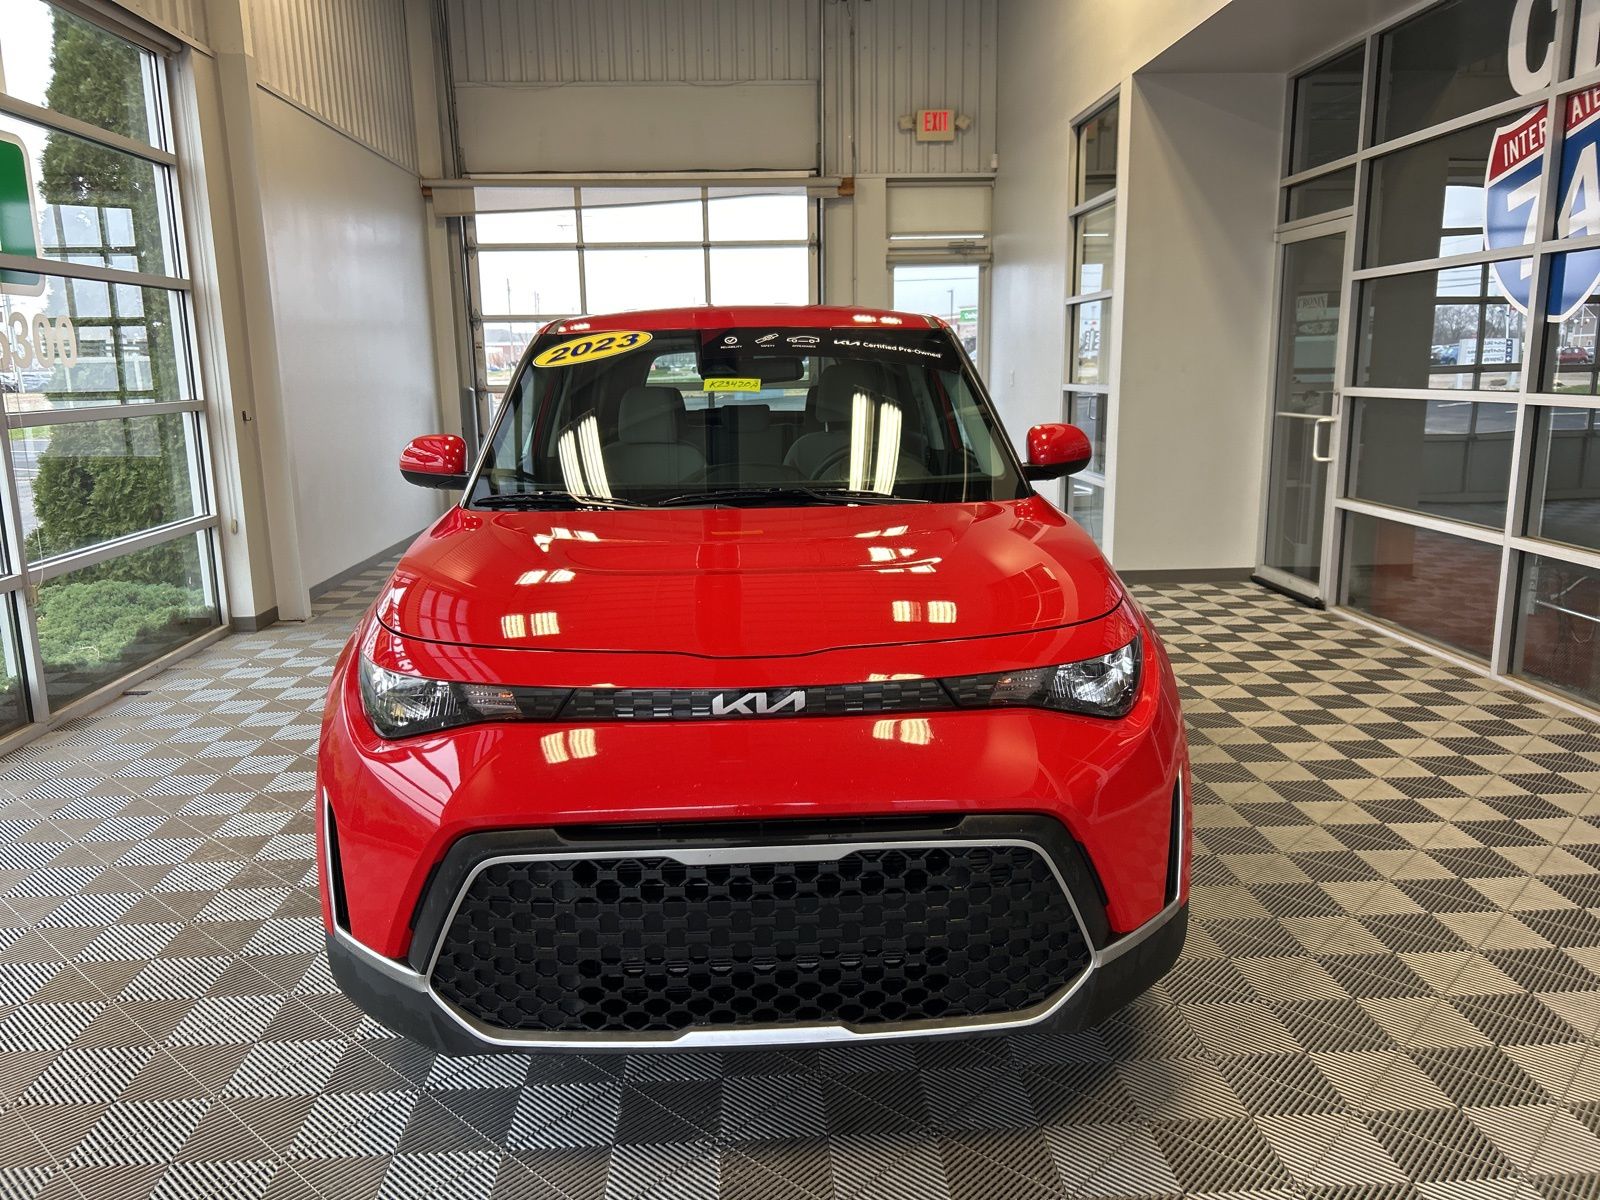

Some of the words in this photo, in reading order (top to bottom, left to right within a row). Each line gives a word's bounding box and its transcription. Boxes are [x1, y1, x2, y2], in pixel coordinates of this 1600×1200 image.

[924, 111, 949, 132] EXIT
[545, 333, 640, 365] 2023
[862, 342, 898, 351] Certified
[898, 346, 943, 359] Pre-Owned
[712, 690, 806, 715] KIA
